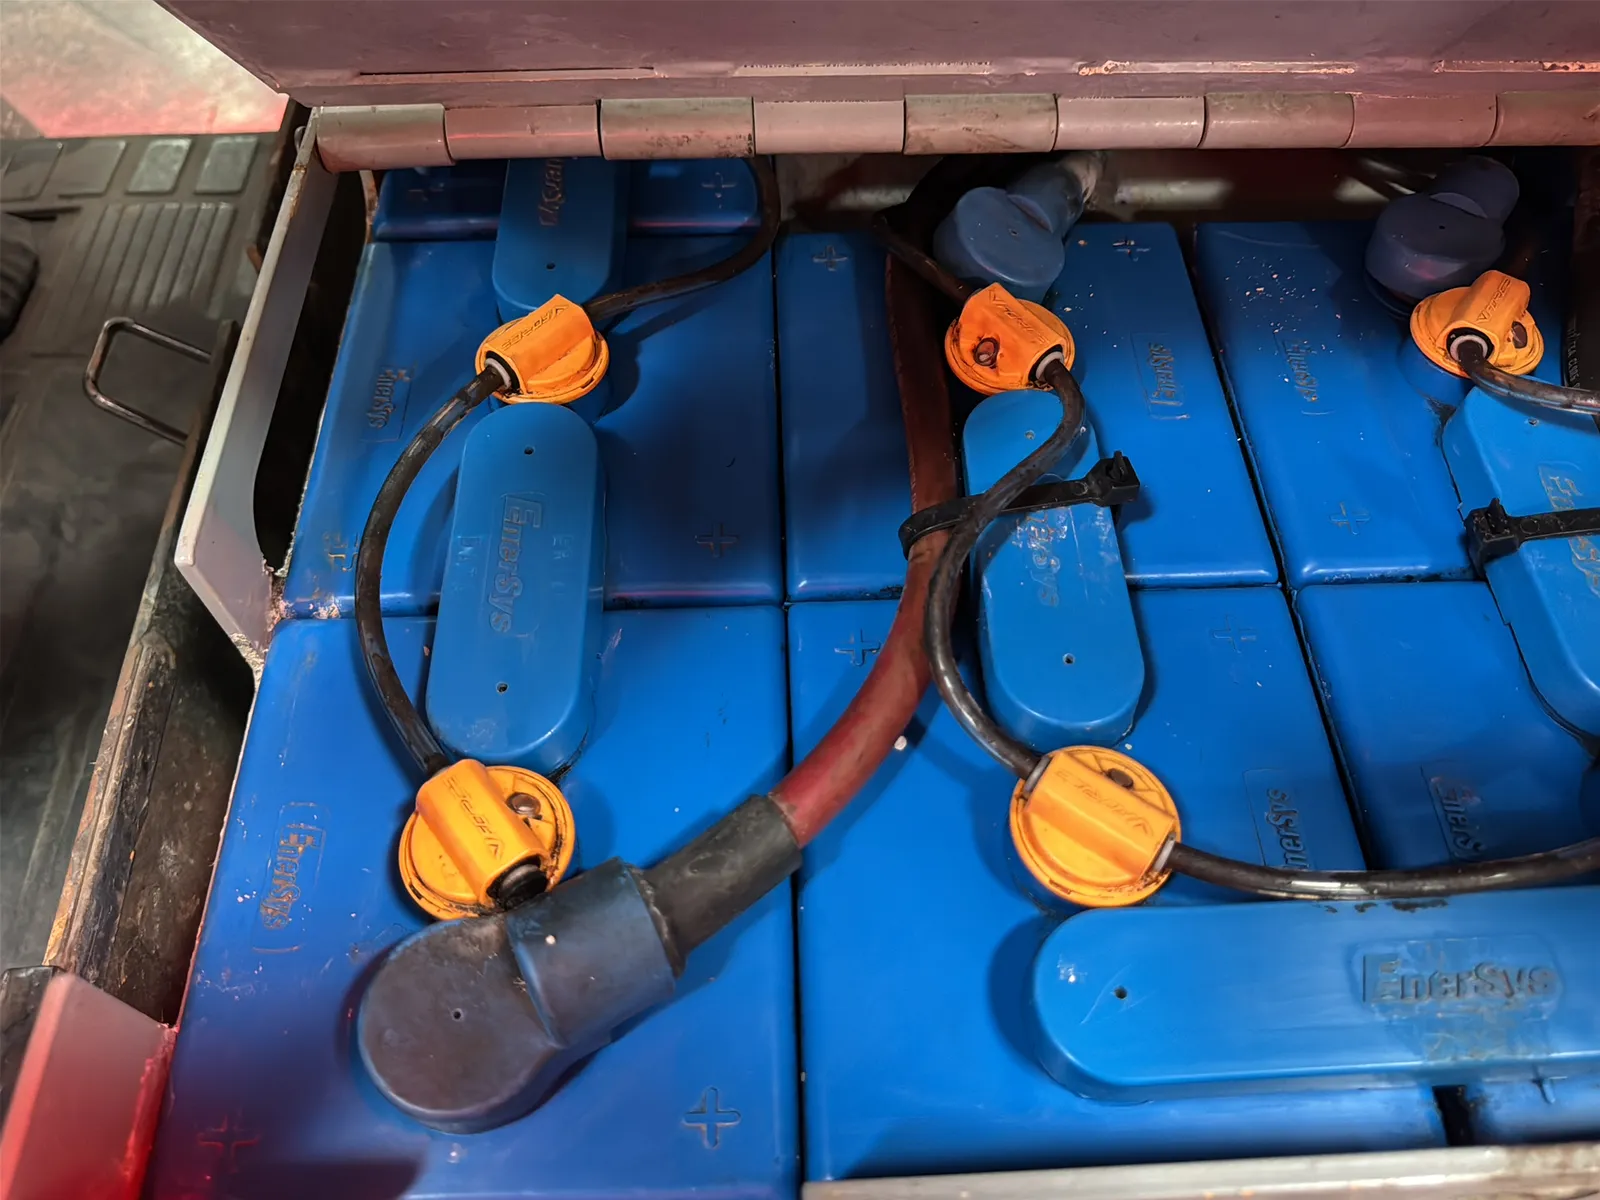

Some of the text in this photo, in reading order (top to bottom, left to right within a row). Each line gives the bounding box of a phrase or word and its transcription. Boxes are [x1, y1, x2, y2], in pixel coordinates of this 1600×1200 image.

[538, 158, 565, 227] nerSys
[488, 495, 543, 634] EnerSys
[1265, 787, 1310, 868] nerSys
[260, 823, 327, 931] EnerSys
[1362, 952, 1557, 1008] EnerSys
